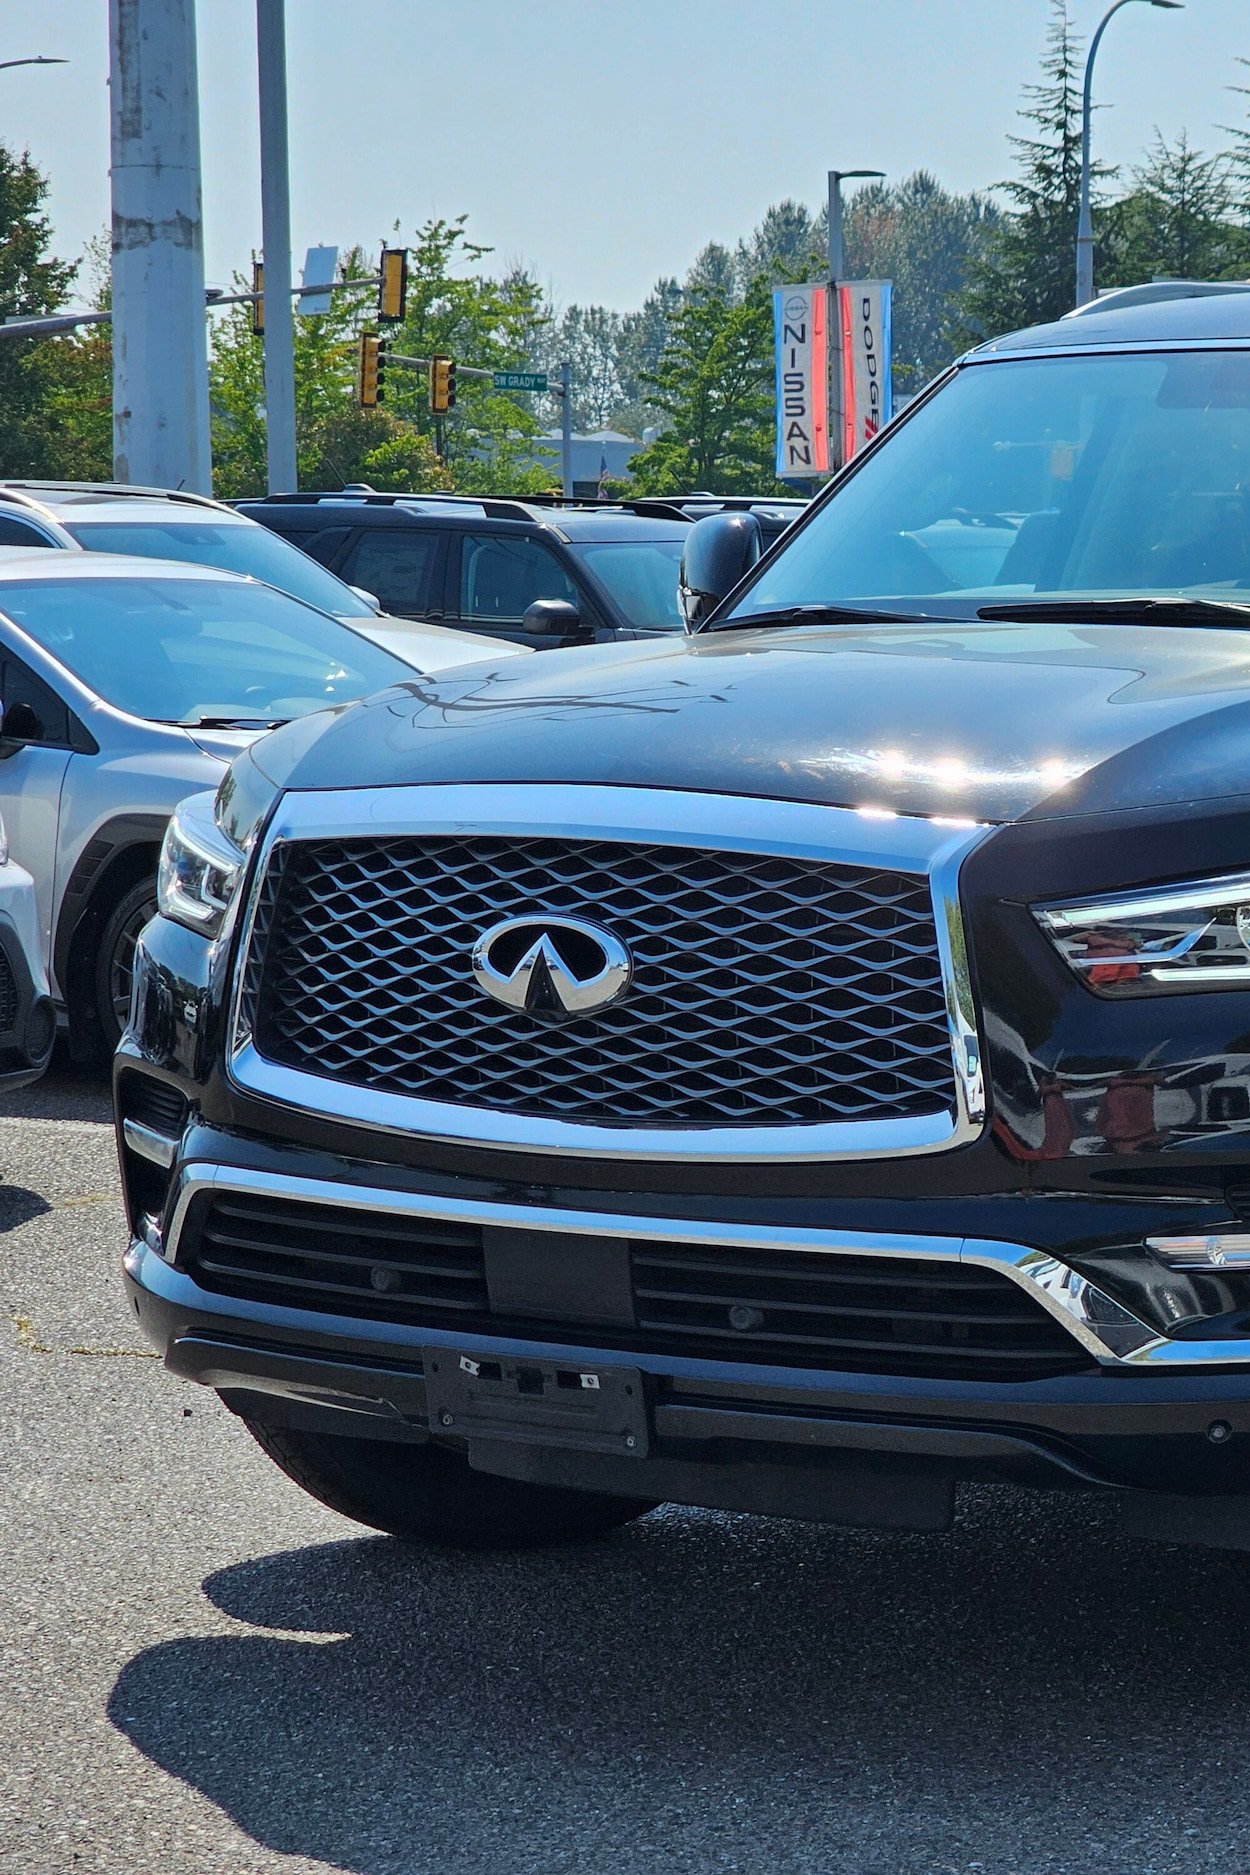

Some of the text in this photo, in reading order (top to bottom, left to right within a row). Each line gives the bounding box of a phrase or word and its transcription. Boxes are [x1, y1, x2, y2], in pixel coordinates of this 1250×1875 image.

[508, 375, 536, 388] GRADY
[783, 323, 812, 466] NISSAN
[862, 297, 880, 431] DODGE
